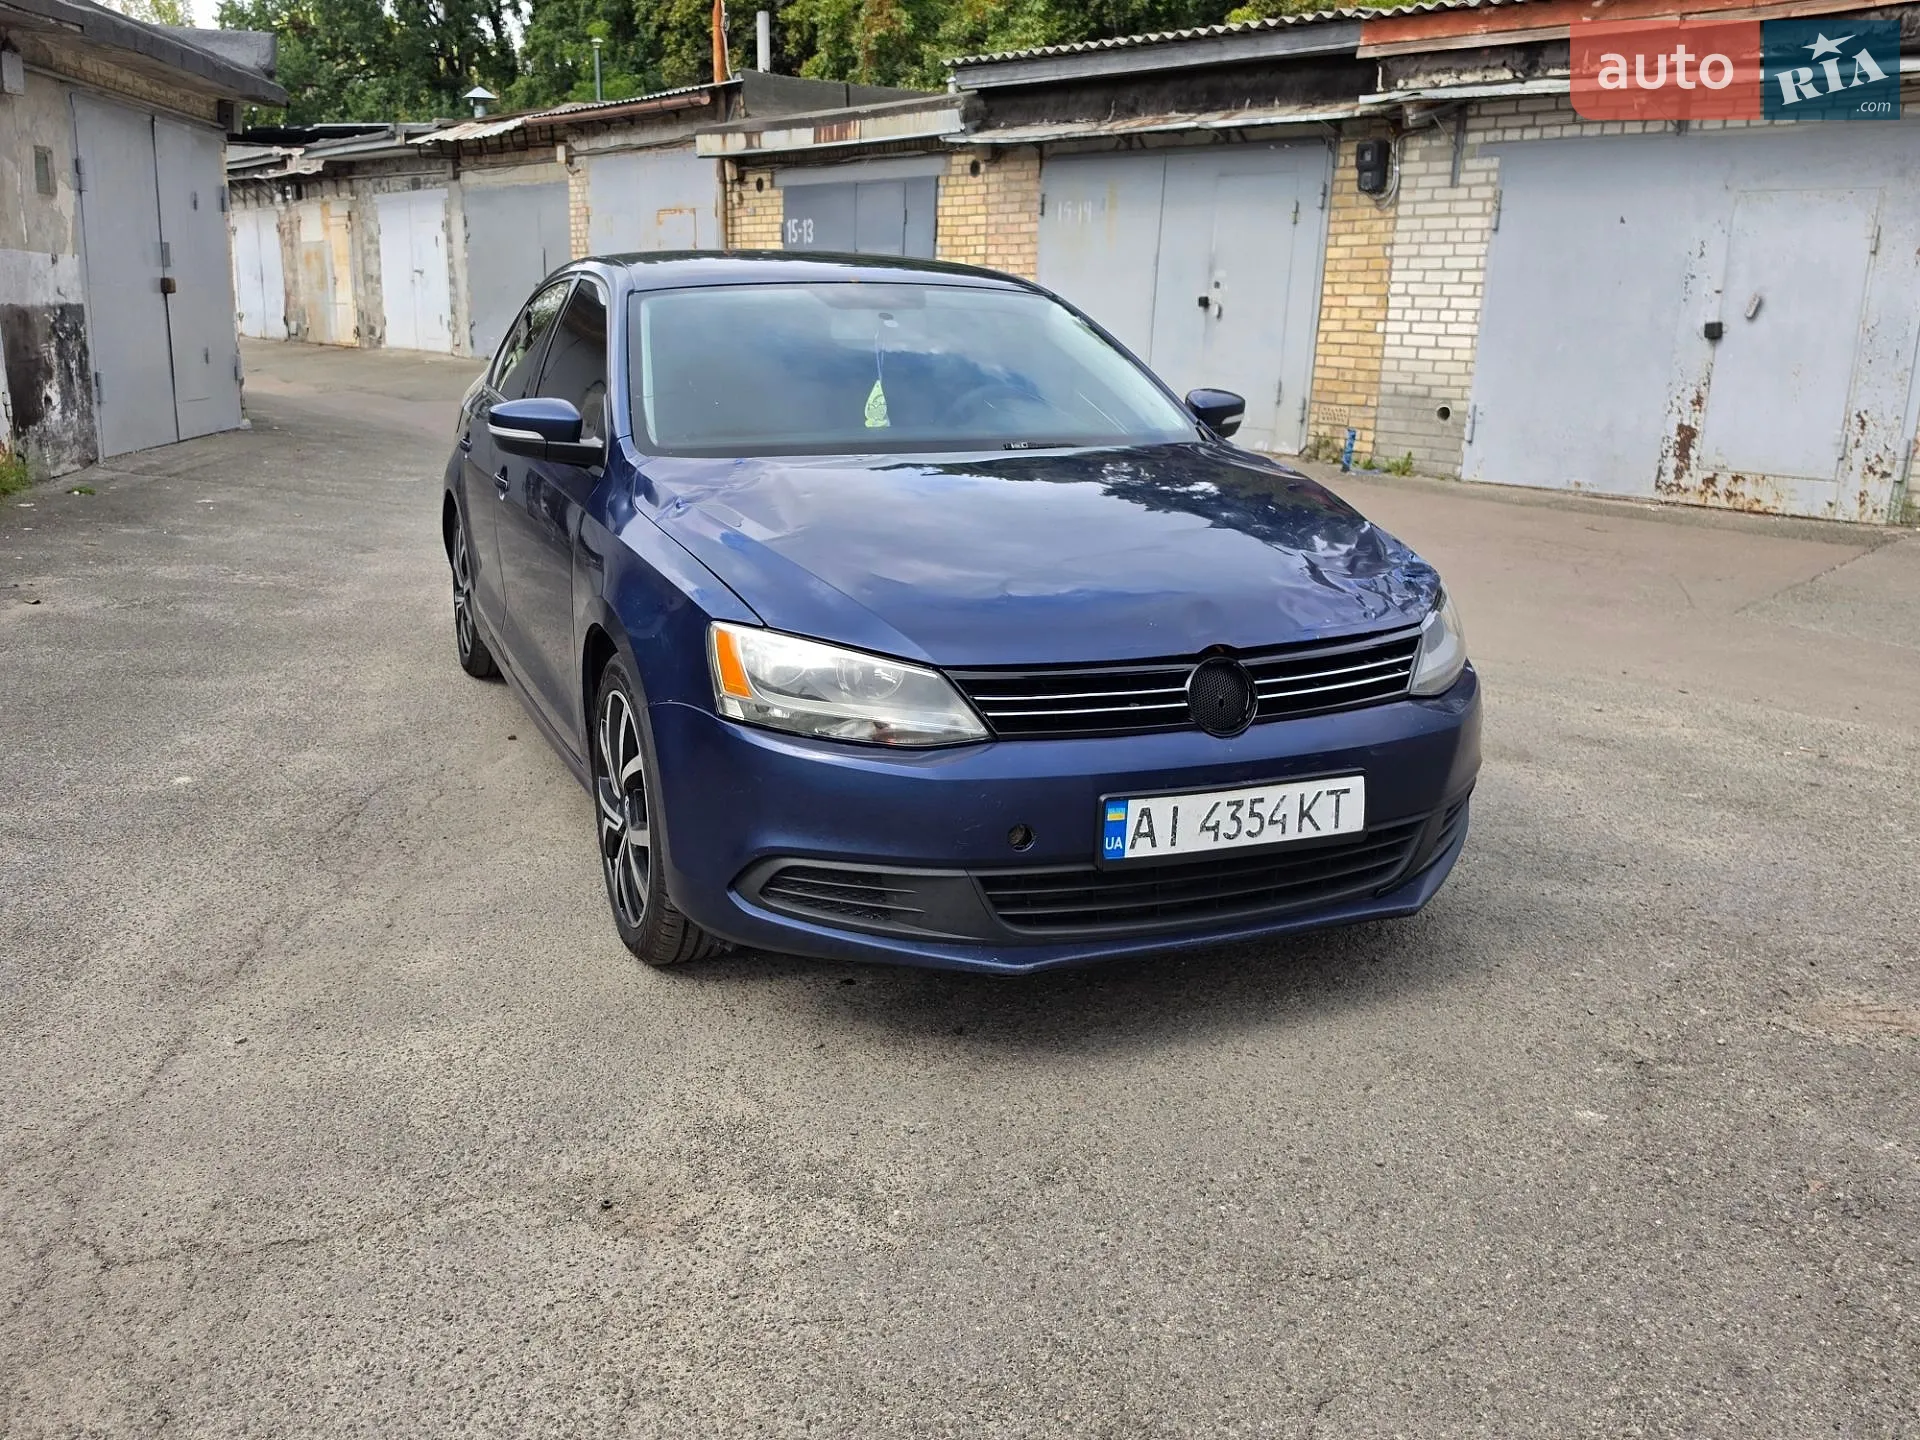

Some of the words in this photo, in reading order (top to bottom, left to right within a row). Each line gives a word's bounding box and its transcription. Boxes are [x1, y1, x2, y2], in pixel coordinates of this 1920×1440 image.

[787, 218, 814, 244] 15-13
[1129, 805, 1179, 850] AI
[1199, 794, 1288, 842] 4354
[1297, 788, 1351, 833] KT
[1105, 837, 1123, 850] UA
